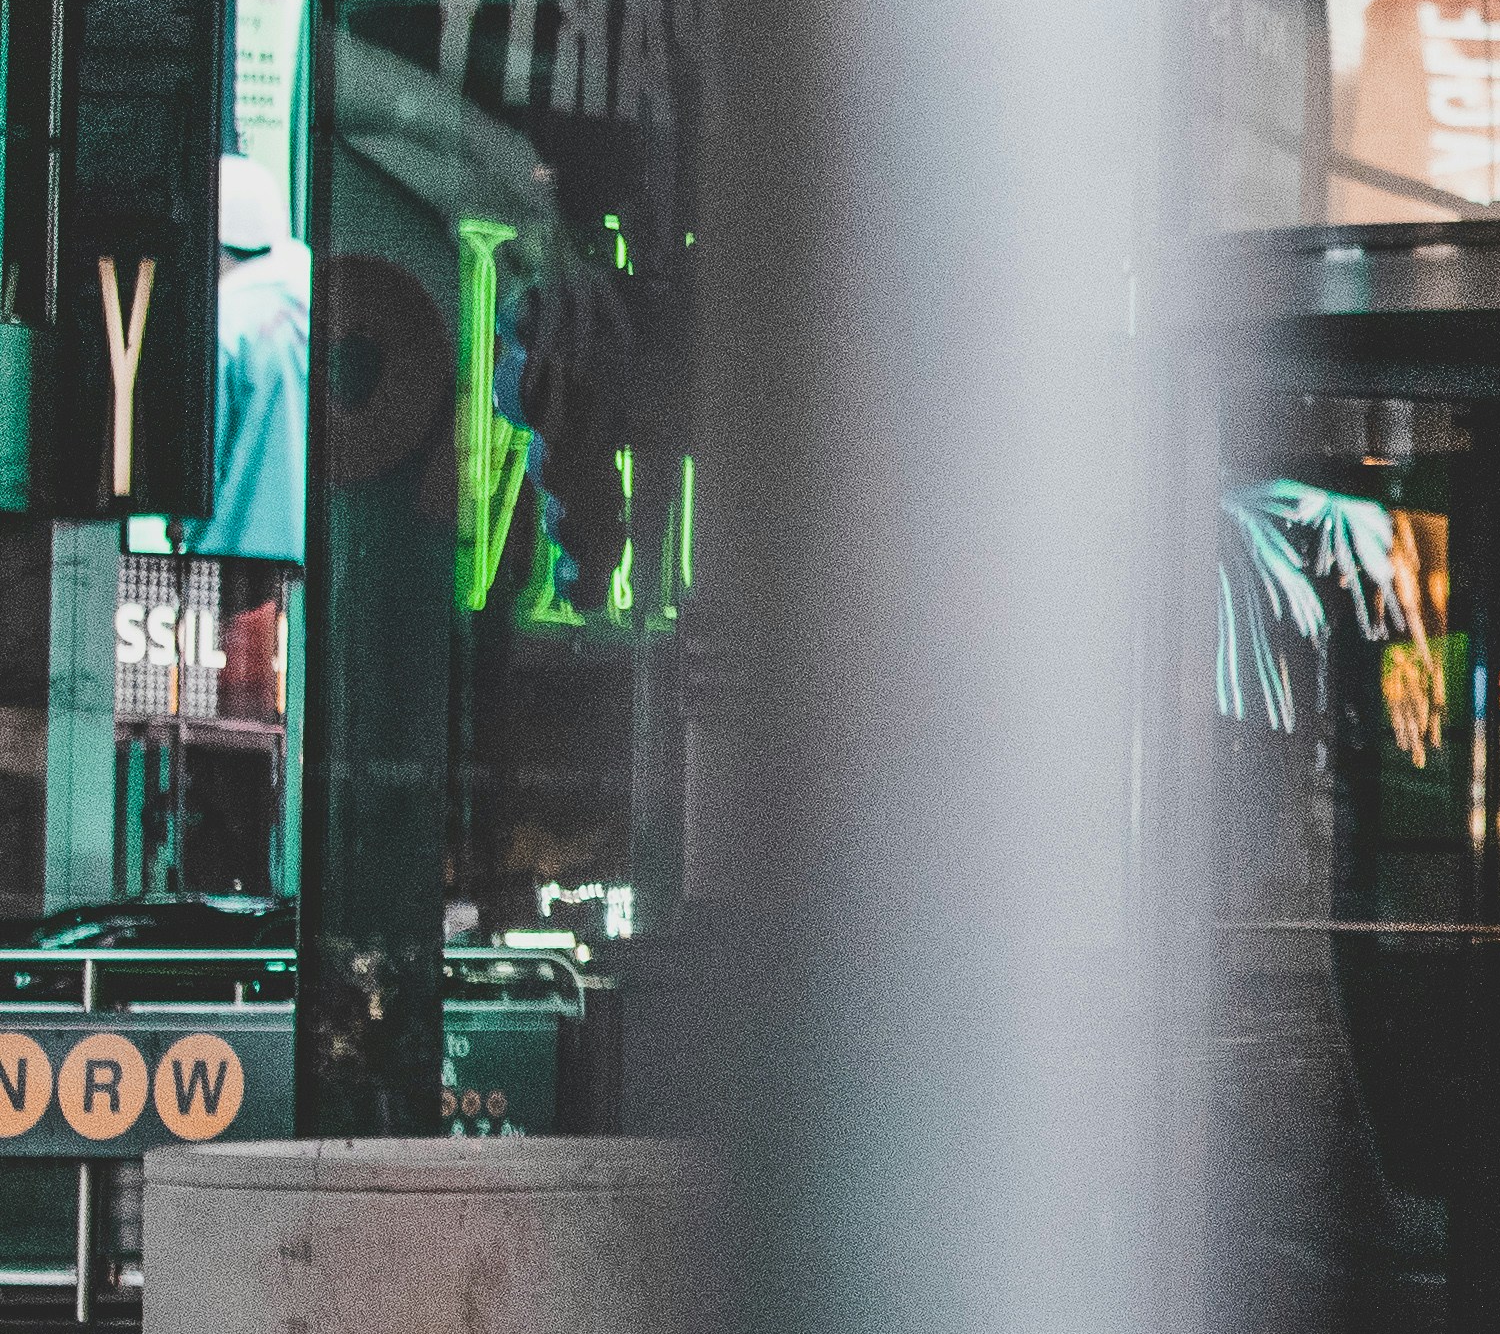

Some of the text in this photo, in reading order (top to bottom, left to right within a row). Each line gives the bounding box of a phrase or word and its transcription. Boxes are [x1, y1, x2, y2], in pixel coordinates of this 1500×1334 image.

[115, 605, 227, 669] SSIL
[84, 1060, 123, 1115] R
[173, 1060, 227, 1115] W
